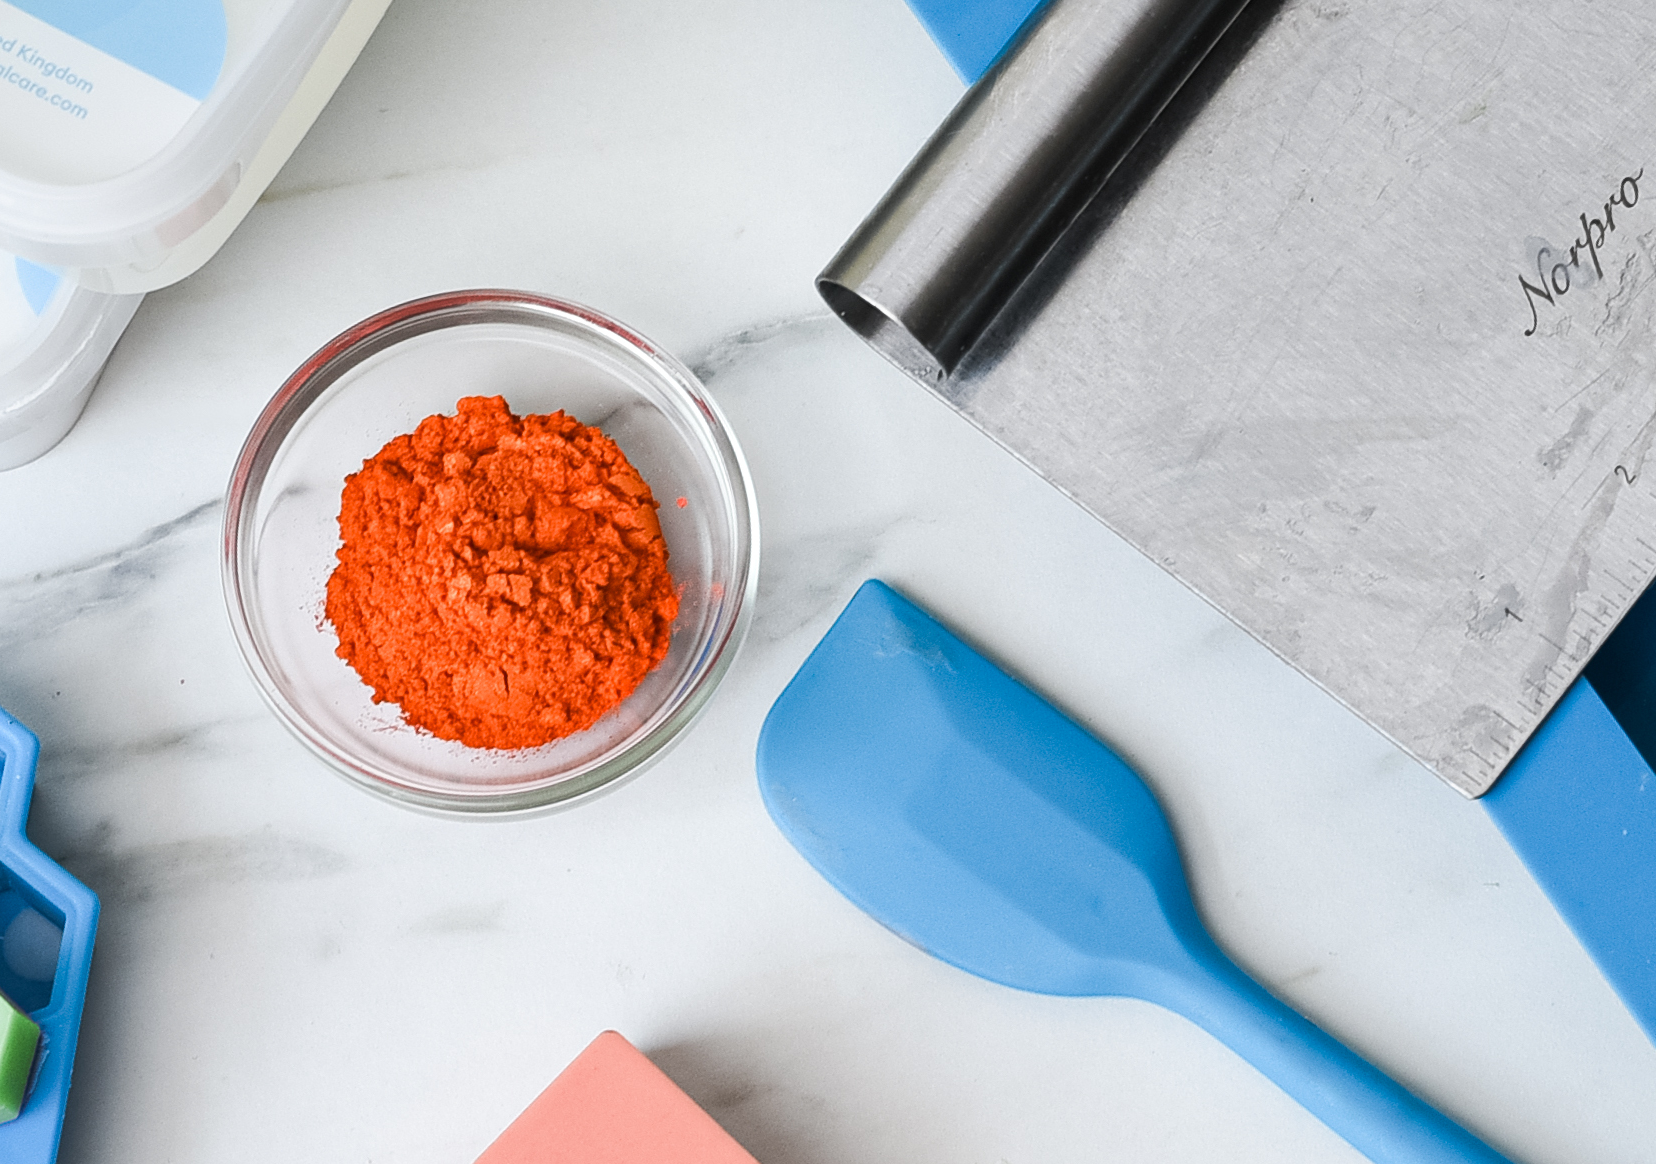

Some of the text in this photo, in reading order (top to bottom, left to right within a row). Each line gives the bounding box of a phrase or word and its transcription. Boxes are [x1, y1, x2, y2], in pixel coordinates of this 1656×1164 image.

[16, 44, 94, 94] Kingdom
[1518, 167, 1644, 337] Norpro
[1614, 465, 1636, 484] 2
[1504, 607, 1523, 622] 1
